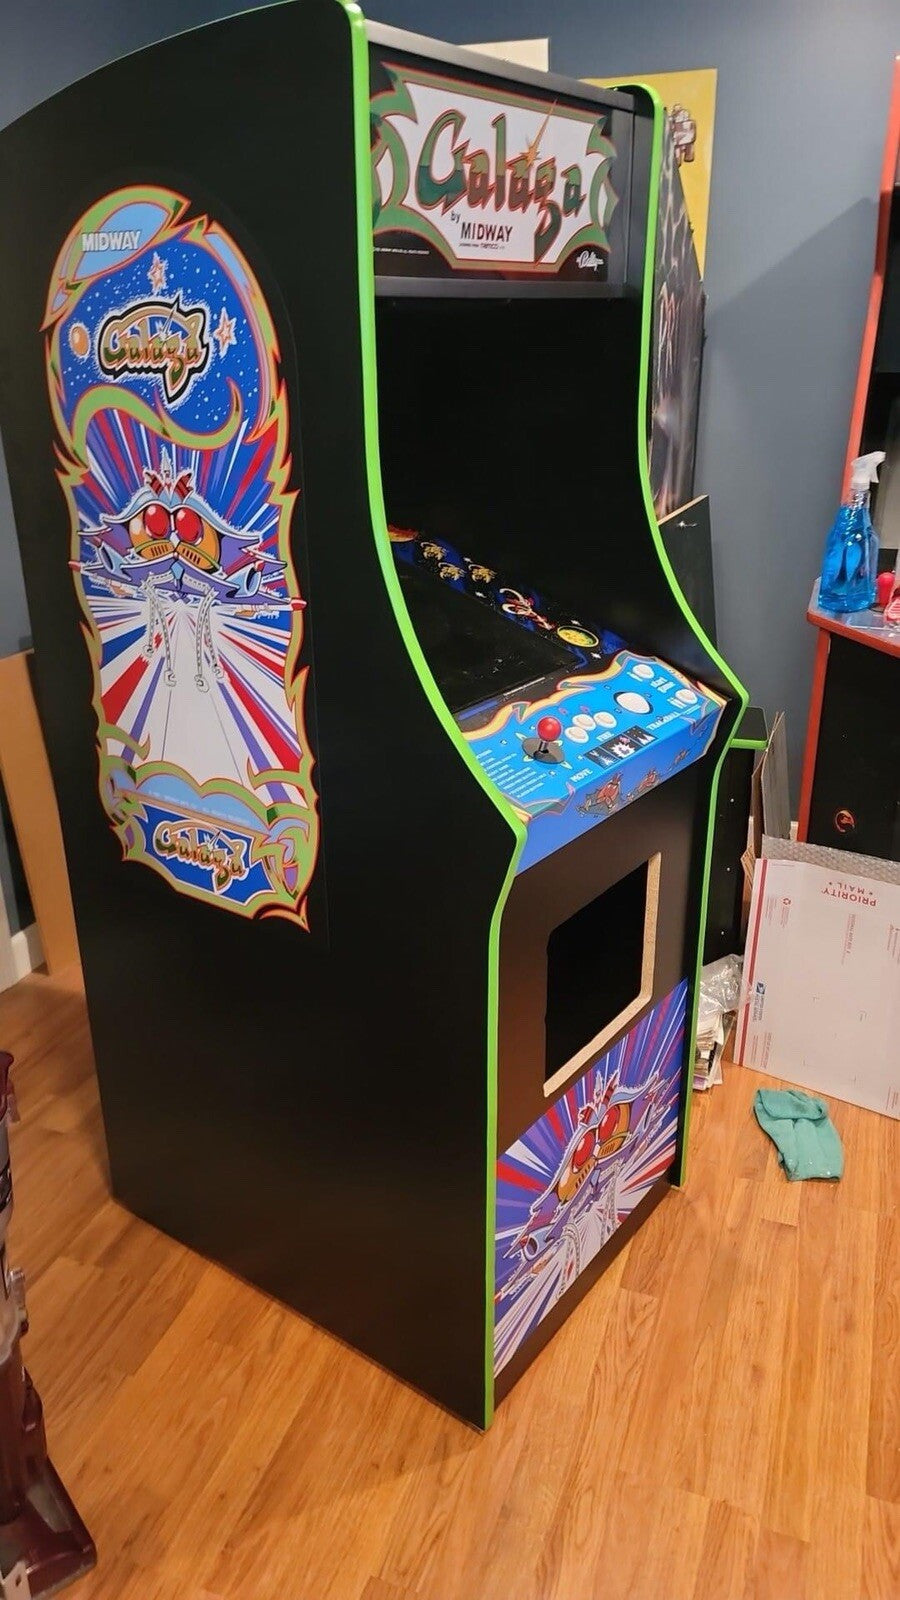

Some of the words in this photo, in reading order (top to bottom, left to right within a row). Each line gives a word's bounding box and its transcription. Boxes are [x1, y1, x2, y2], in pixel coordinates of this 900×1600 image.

[415, 107, 587, 268] Galaga
[450, 210, 461, 224] by
[81, 230, 141, 252] MIDWAY
[460, 221, 513, 243] MIDWAY
[101, 302, 207, 392] Galaga
[569, 767, 594, 783] MOVE
[153, 818, 249, 893] Galaga
[823, 887, 877, 907] PRIORITY
[837, 882, 865, 895] MAIL
